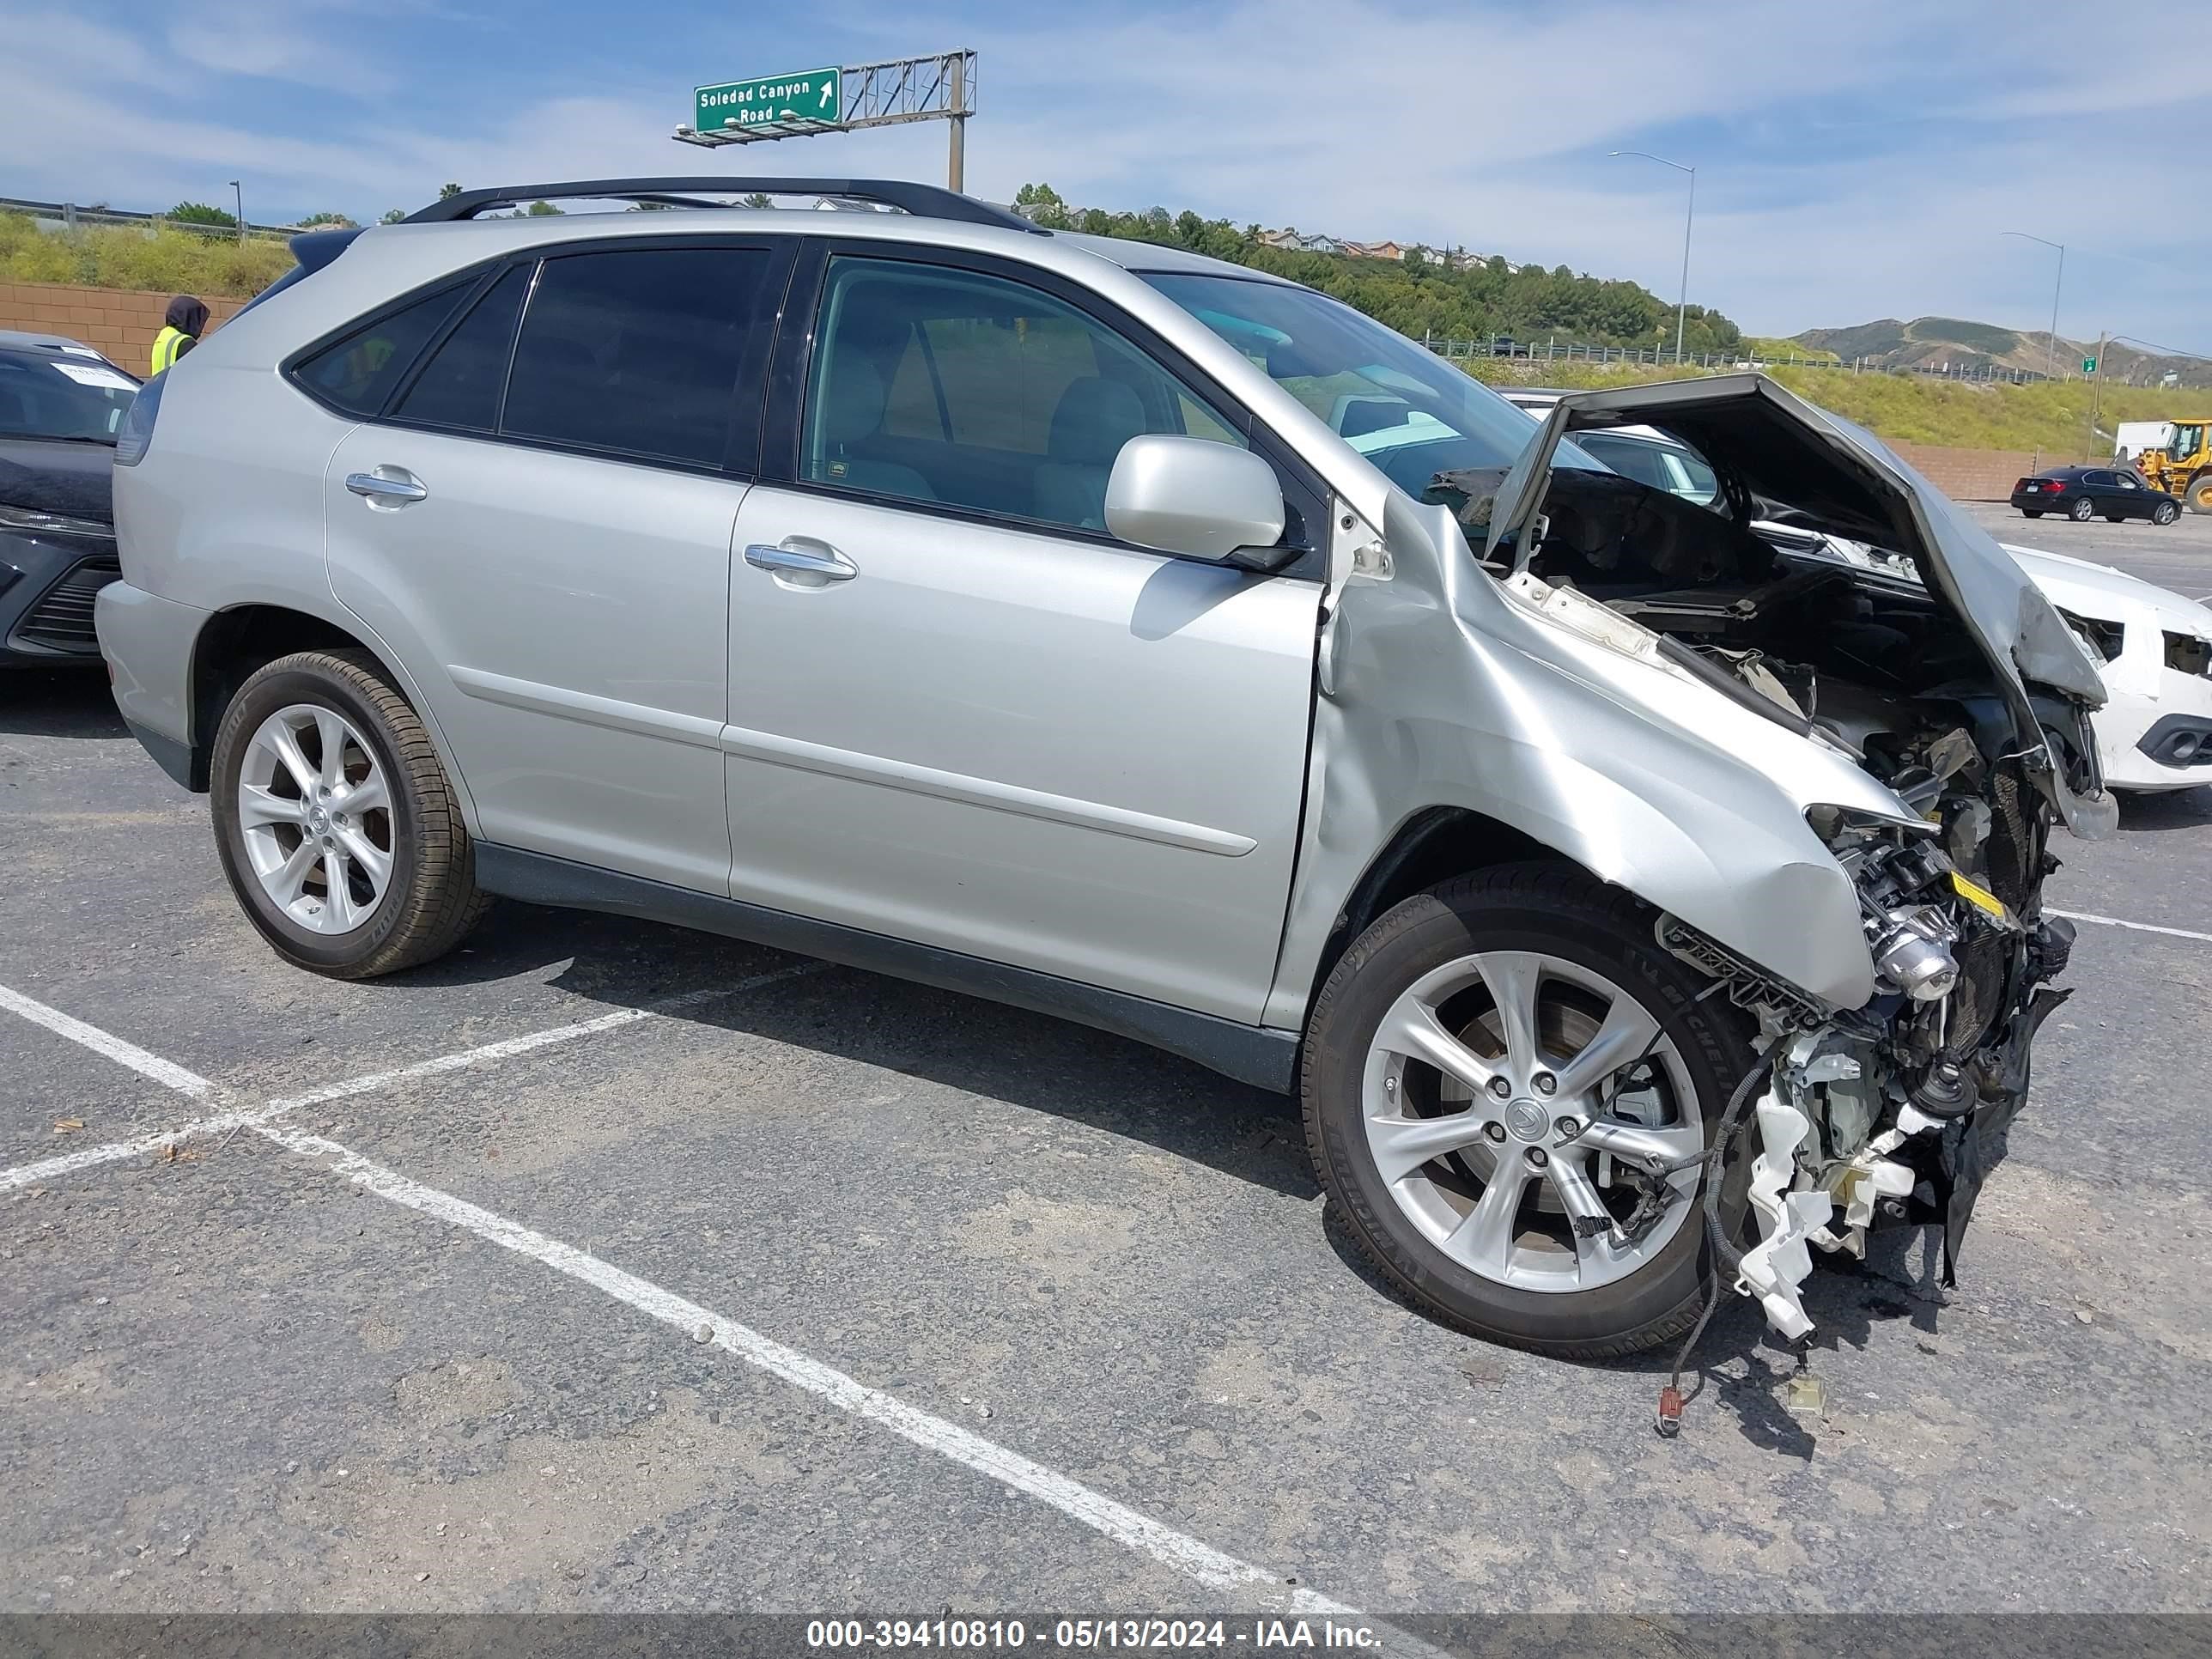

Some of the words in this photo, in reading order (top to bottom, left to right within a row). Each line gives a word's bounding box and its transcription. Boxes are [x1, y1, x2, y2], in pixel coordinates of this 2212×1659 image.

[701, 87, 753, 108] Soledad
[759, 82, 810, 101] Canyon
[740, 106, 773, 124] Road
